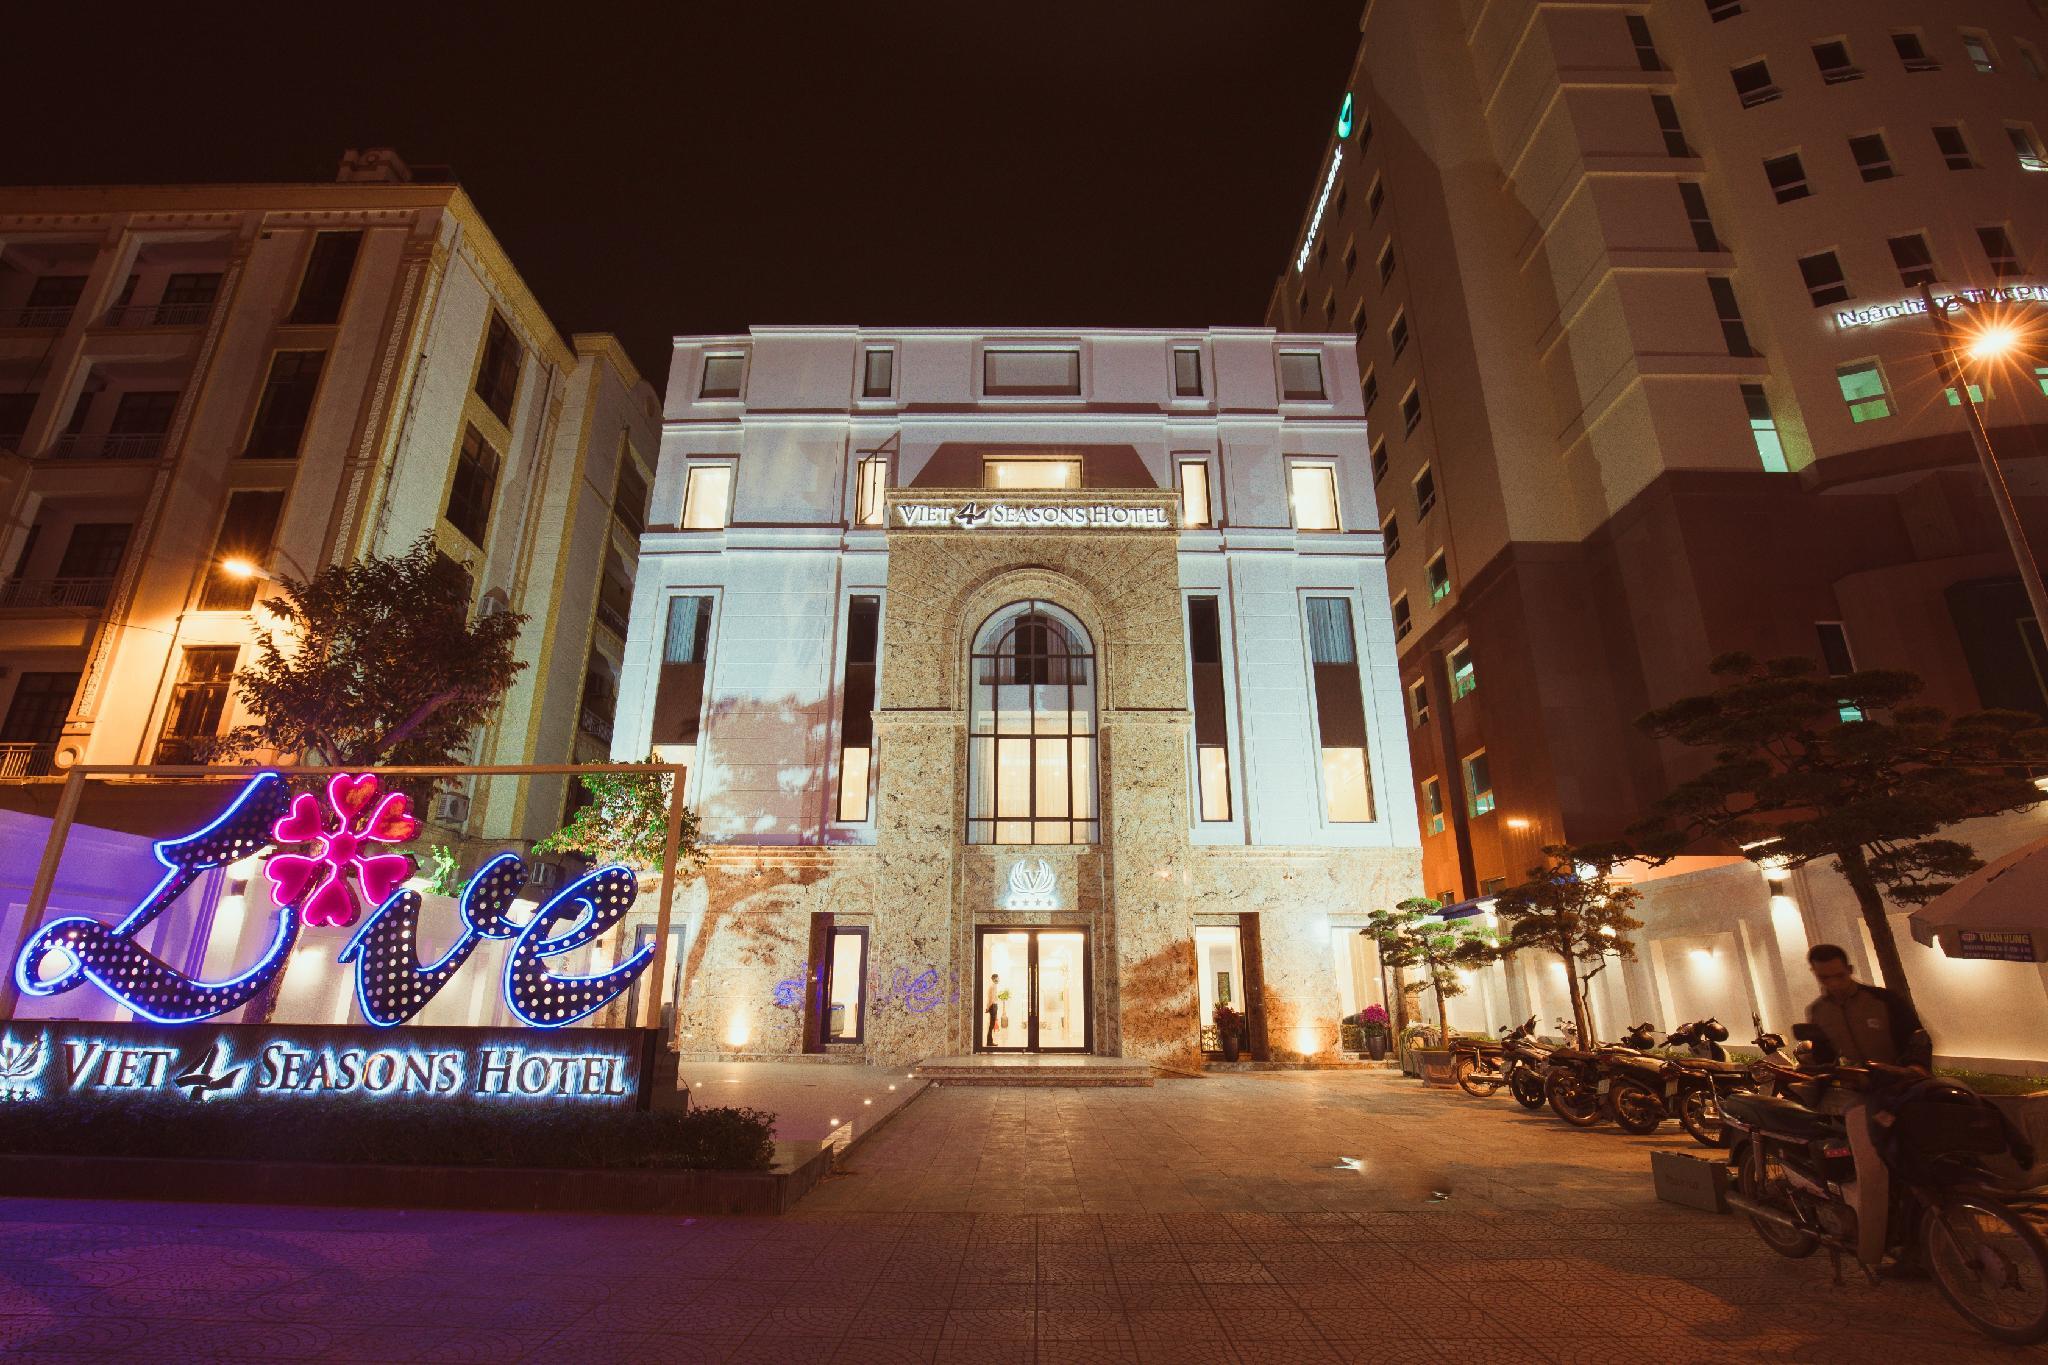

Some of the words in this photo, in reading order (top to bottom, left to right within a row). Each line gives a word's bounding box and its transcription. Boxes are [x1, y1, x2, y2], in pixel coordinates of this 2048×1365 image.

[899, 504, 952, 523] VIET
[956, 501, 988, 525] 4
[993, 504, 1086, 523] SEASONS
[1091, 505, 1169, 523] HOTEL
[62, 1043, 172, 1088] VIET
[174, 1042, 244, 1101] 4
[256, 1045, 458, 1092] SEASONS
[475, 1049, 626, 1096] HOTEL
